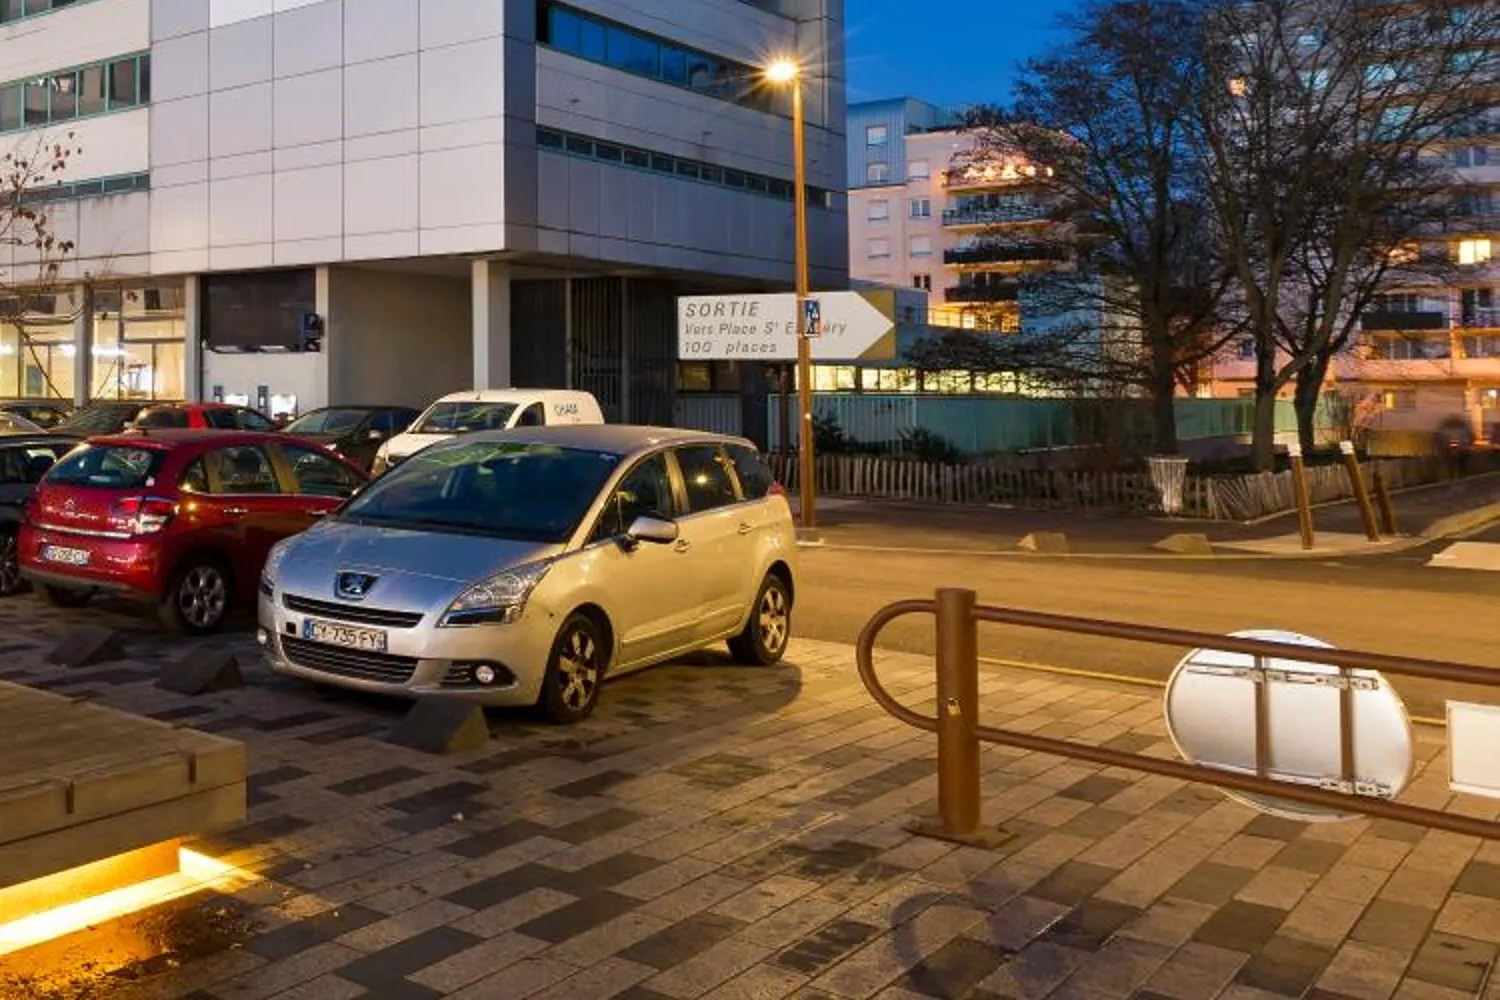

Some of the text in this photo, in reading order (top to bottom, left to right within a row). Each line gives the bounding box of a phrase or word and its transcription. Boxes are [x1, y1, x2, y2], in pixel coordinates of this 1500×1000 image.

[685, 301, 761, 317] SORTIE
[685, 323, 714, 335] Vers
[719, 322, 757, 335] Place
[685, 341, 778, 356] 100 places
